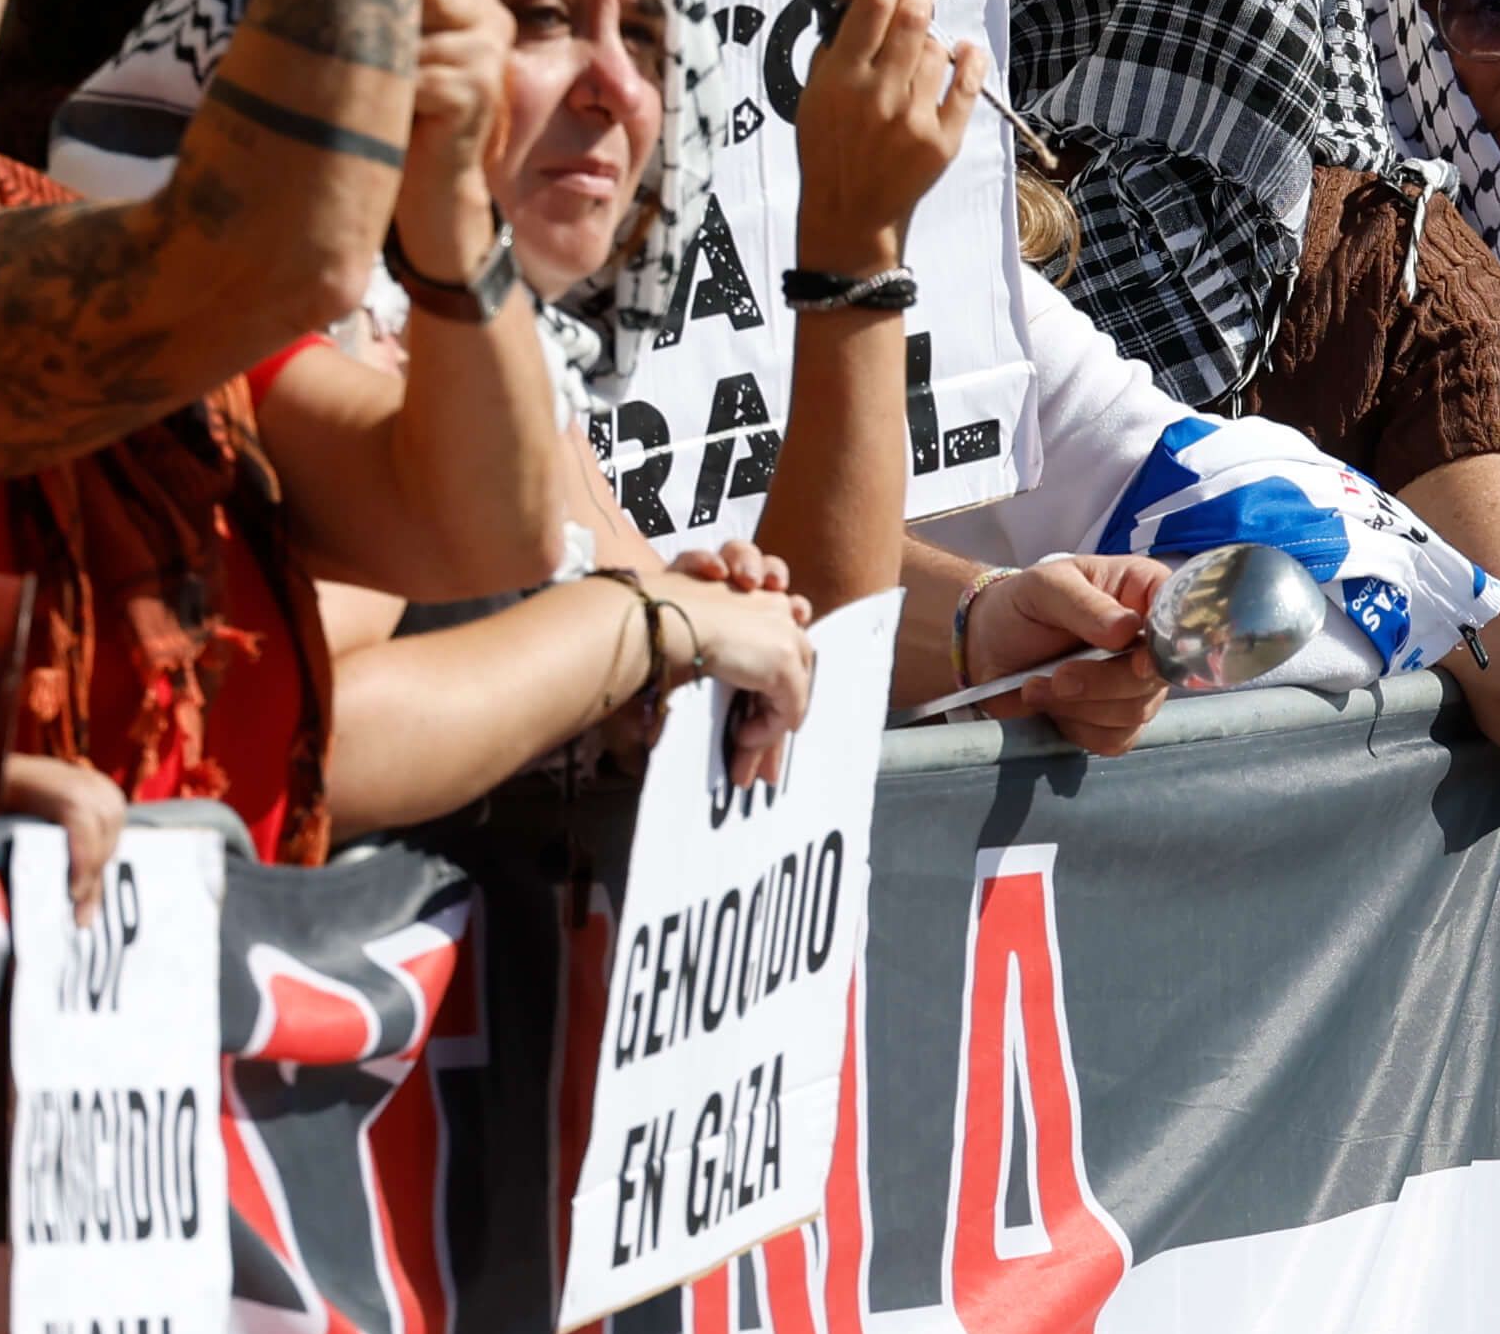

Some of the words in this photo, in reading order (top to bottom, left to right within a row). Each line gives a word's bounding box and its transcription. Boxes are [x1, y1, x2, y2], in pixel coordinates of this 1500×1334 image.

[615, 829, 843, 1070] GENOCIDIO
[611, 1110, 678, 1269] EN
[684, 1053, 784, 1238] GAZA
